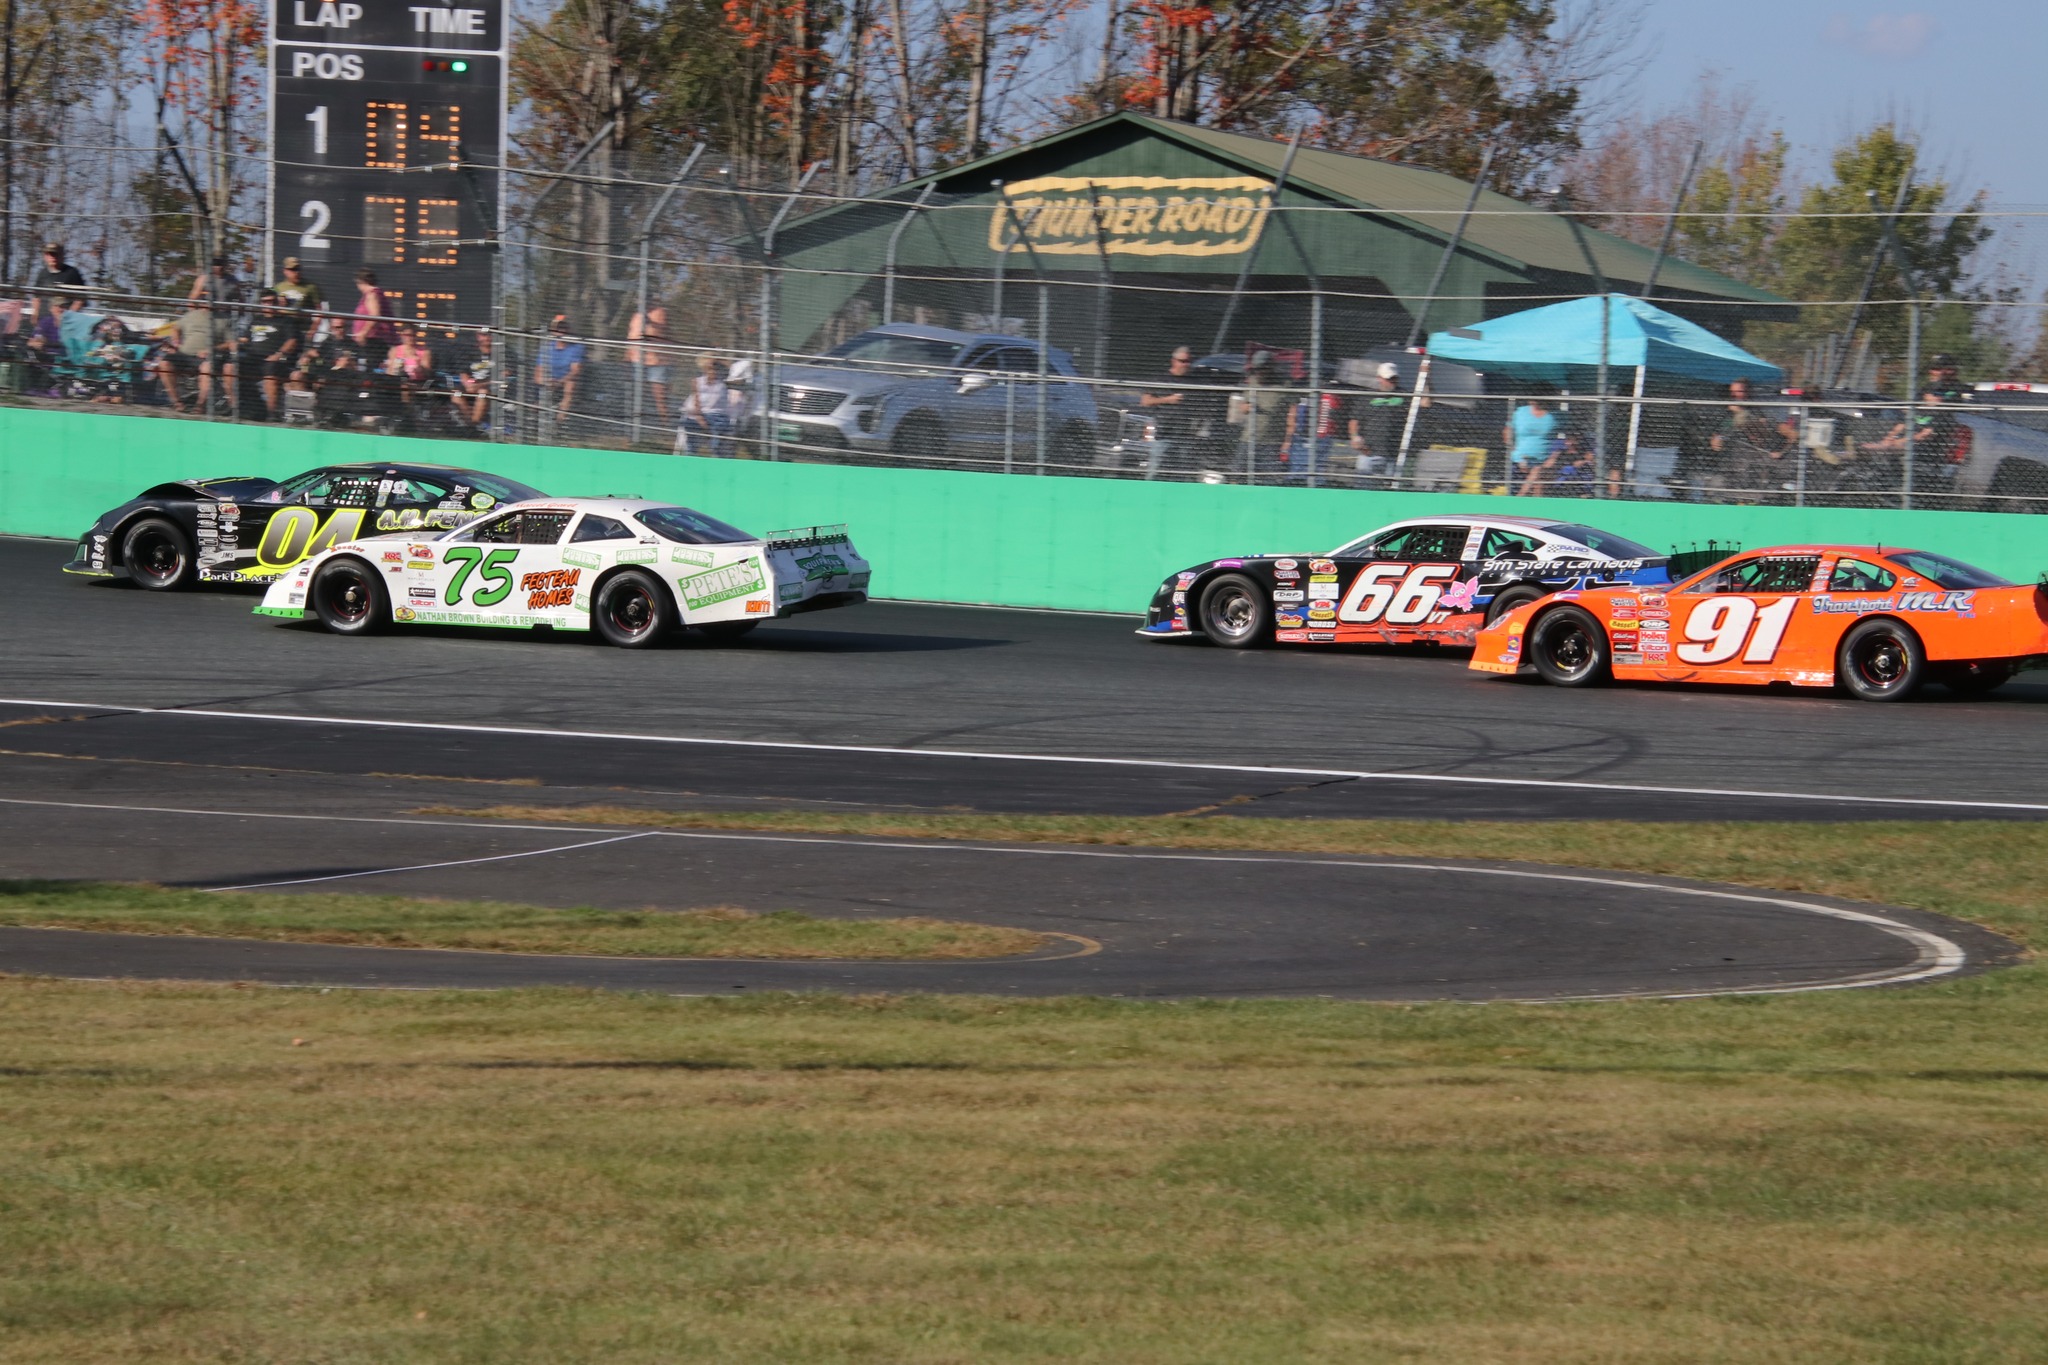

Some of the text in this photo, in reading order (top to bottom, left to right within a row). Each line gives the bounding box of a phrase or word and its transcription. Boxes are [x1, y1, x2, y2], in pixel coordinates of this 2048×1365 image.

[294, 1, 363, 28] LAP
[408, 7, 486, 34] TIME
[293, 52, 364, 80] POS
[305, 106, 327, 154] 1
[366, 102, 460, 169] 04
[300, 200, 331, 248] 2
[1158, 196, 1255, 234] ROAD
[366, 196, 459, 264] 75
[256, 506, 366, 568] 04
[443, 547, 521, 607] 75
[520, 568, 581, 592] FECTEAU
[691, 562, 756, 599] PETE'S
[410, 599, 435, 607] tilton
[528, 588, 575, 610] HOMES
[699, 584, 754, 606] EQUIPMENT
[1338, 563, 1459, 626] 66
[1813, 595, 1894, 615] Transport
[417, 611, 567, 627] NATHAN BROWN BUILDING & REMODELING
[1426, 611, 1450, 624] VT
[1677, 596, 1799, 665] 91
[1641, 631, 1665, 641] Holley
